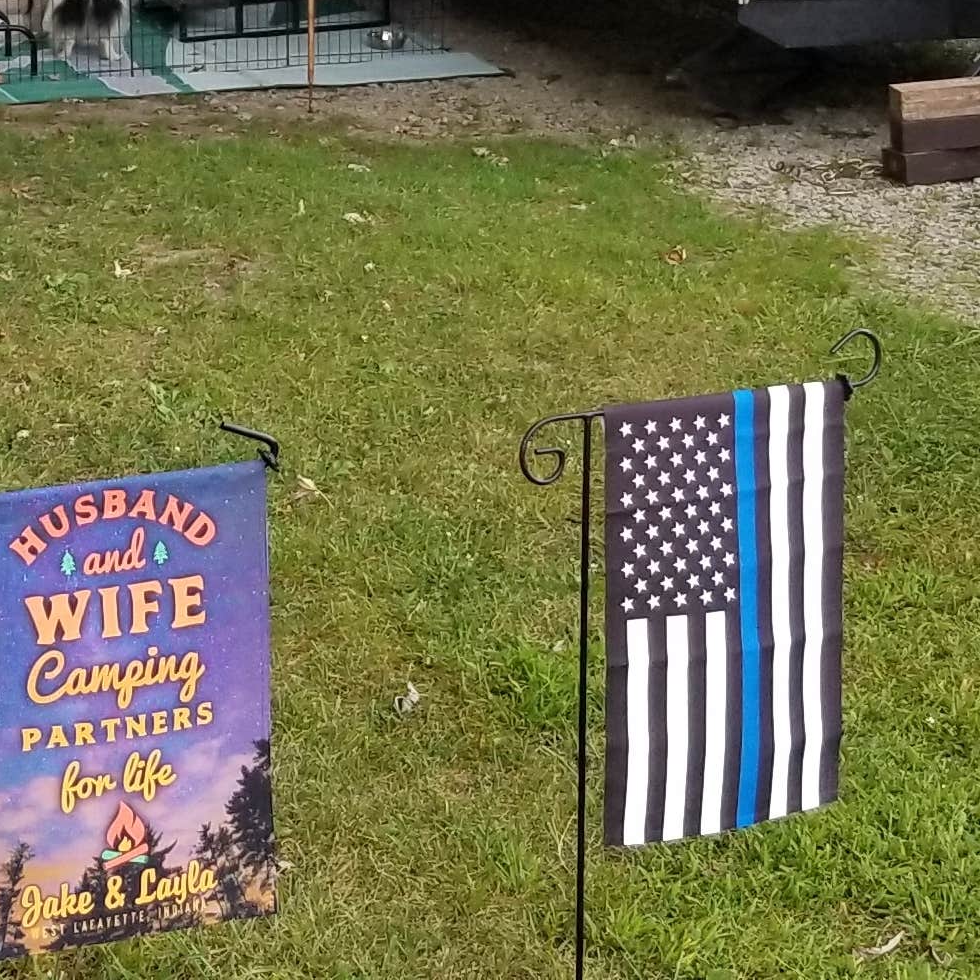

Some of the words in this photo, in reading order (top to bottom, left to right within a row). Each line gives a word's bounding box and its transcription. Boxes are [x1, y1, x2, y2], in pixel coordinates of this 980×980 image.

[9, 489, 217, 566] HUSBAND
[83, 527, 146, 575] and
[25, 575, 206, 645] WIFE
[26, 646, 205, 709] Camping
[22, 702, 214, 752] PARTNERS
[62, 761, 117, 813] for
[123, 749, 177, 801] life
[21, 883, 95, 928] Jake
[105, 875, 125, 909] &
[135, 859, 218, 905] Layla
